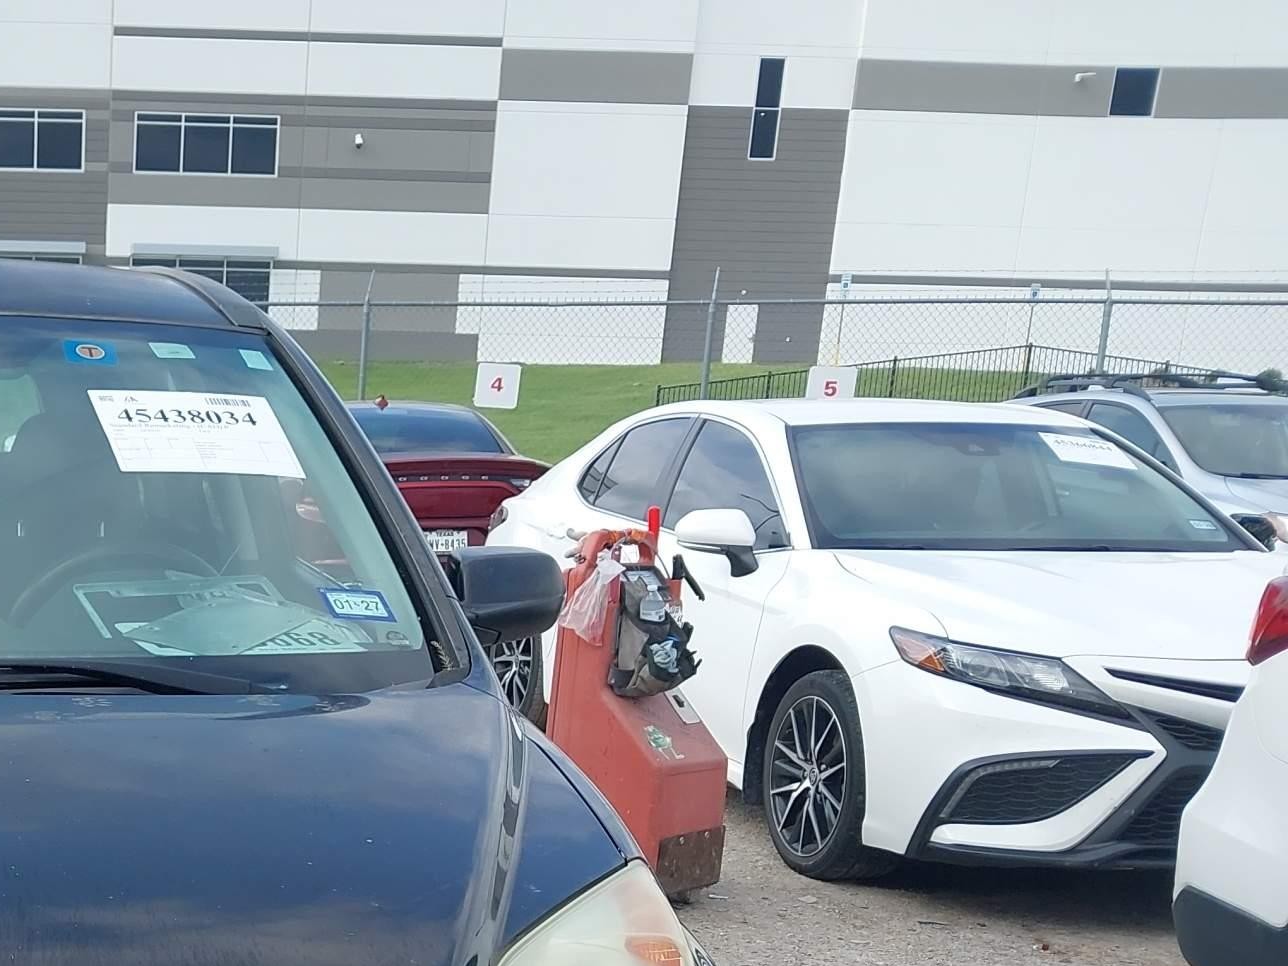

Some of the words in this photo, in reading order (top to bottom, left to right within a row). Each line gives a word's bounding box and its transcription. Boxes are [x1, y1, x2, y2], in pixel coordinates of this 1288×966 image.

[490, 377, 504, 392] 4
[823, 380, 838, 397] 5
[117, 408, 258, 426] 45438034
